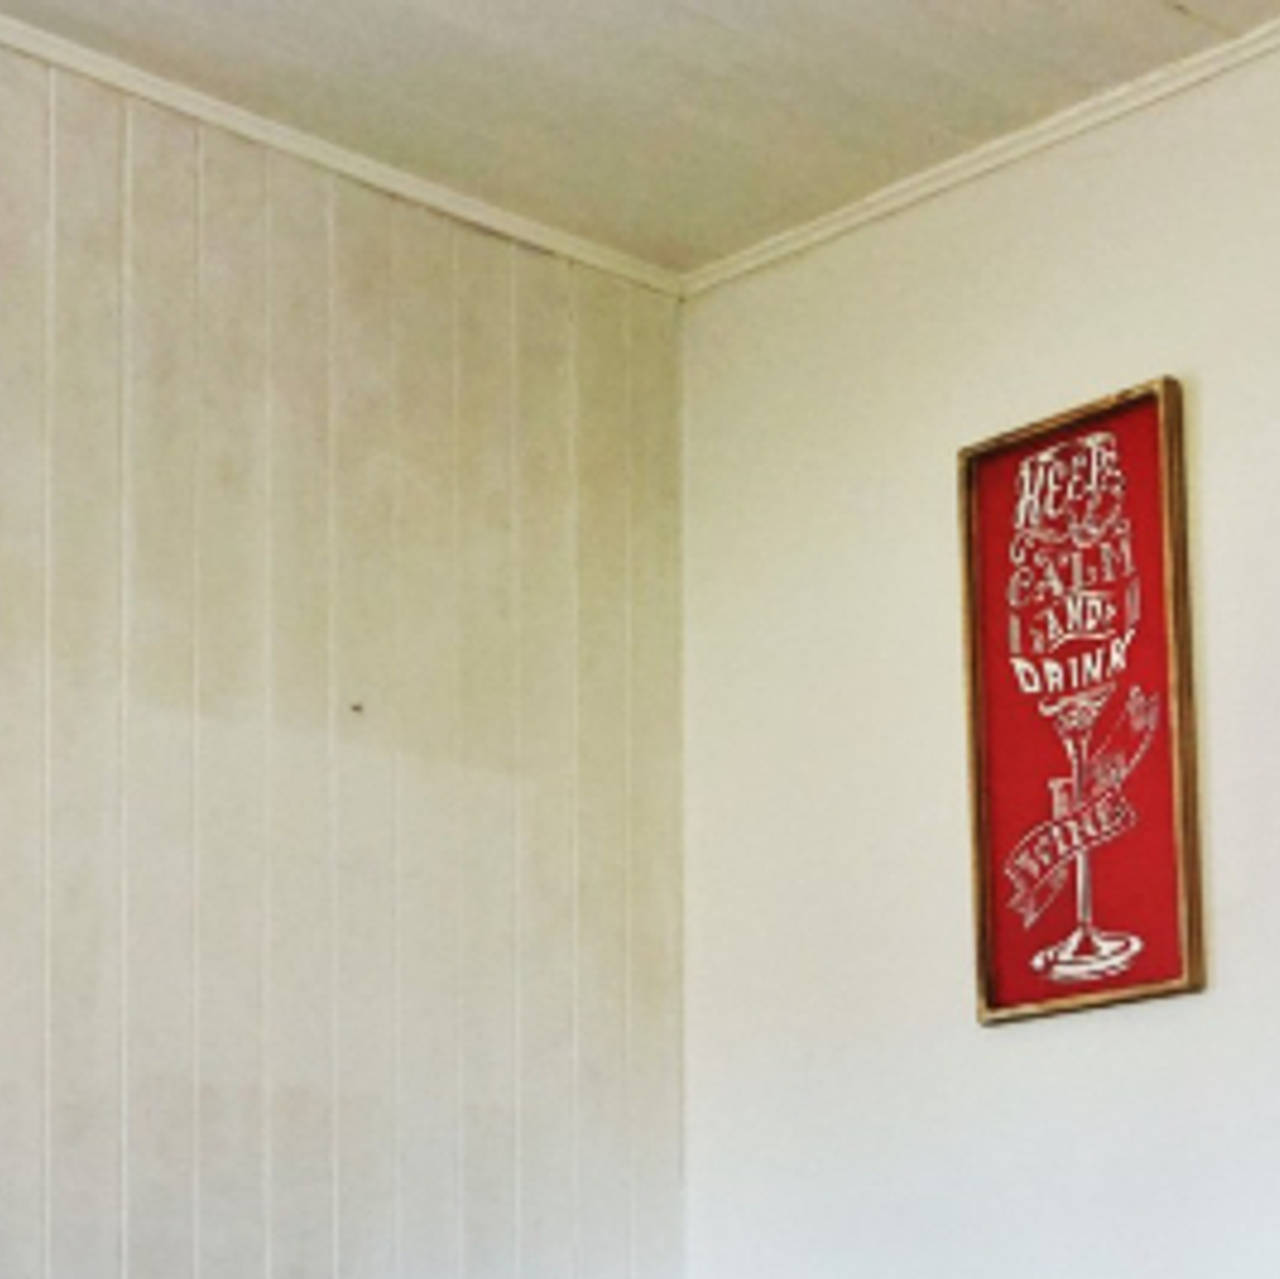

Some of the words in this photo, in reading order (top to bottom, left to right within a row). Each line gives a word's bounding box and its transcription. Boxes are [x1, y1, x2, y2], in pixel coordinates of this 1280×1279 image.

[1007, 536, 1136, 607] CALM
[1043, 597, 1105, 642] AND
[1010, 628, 1136, 692] DRINK
